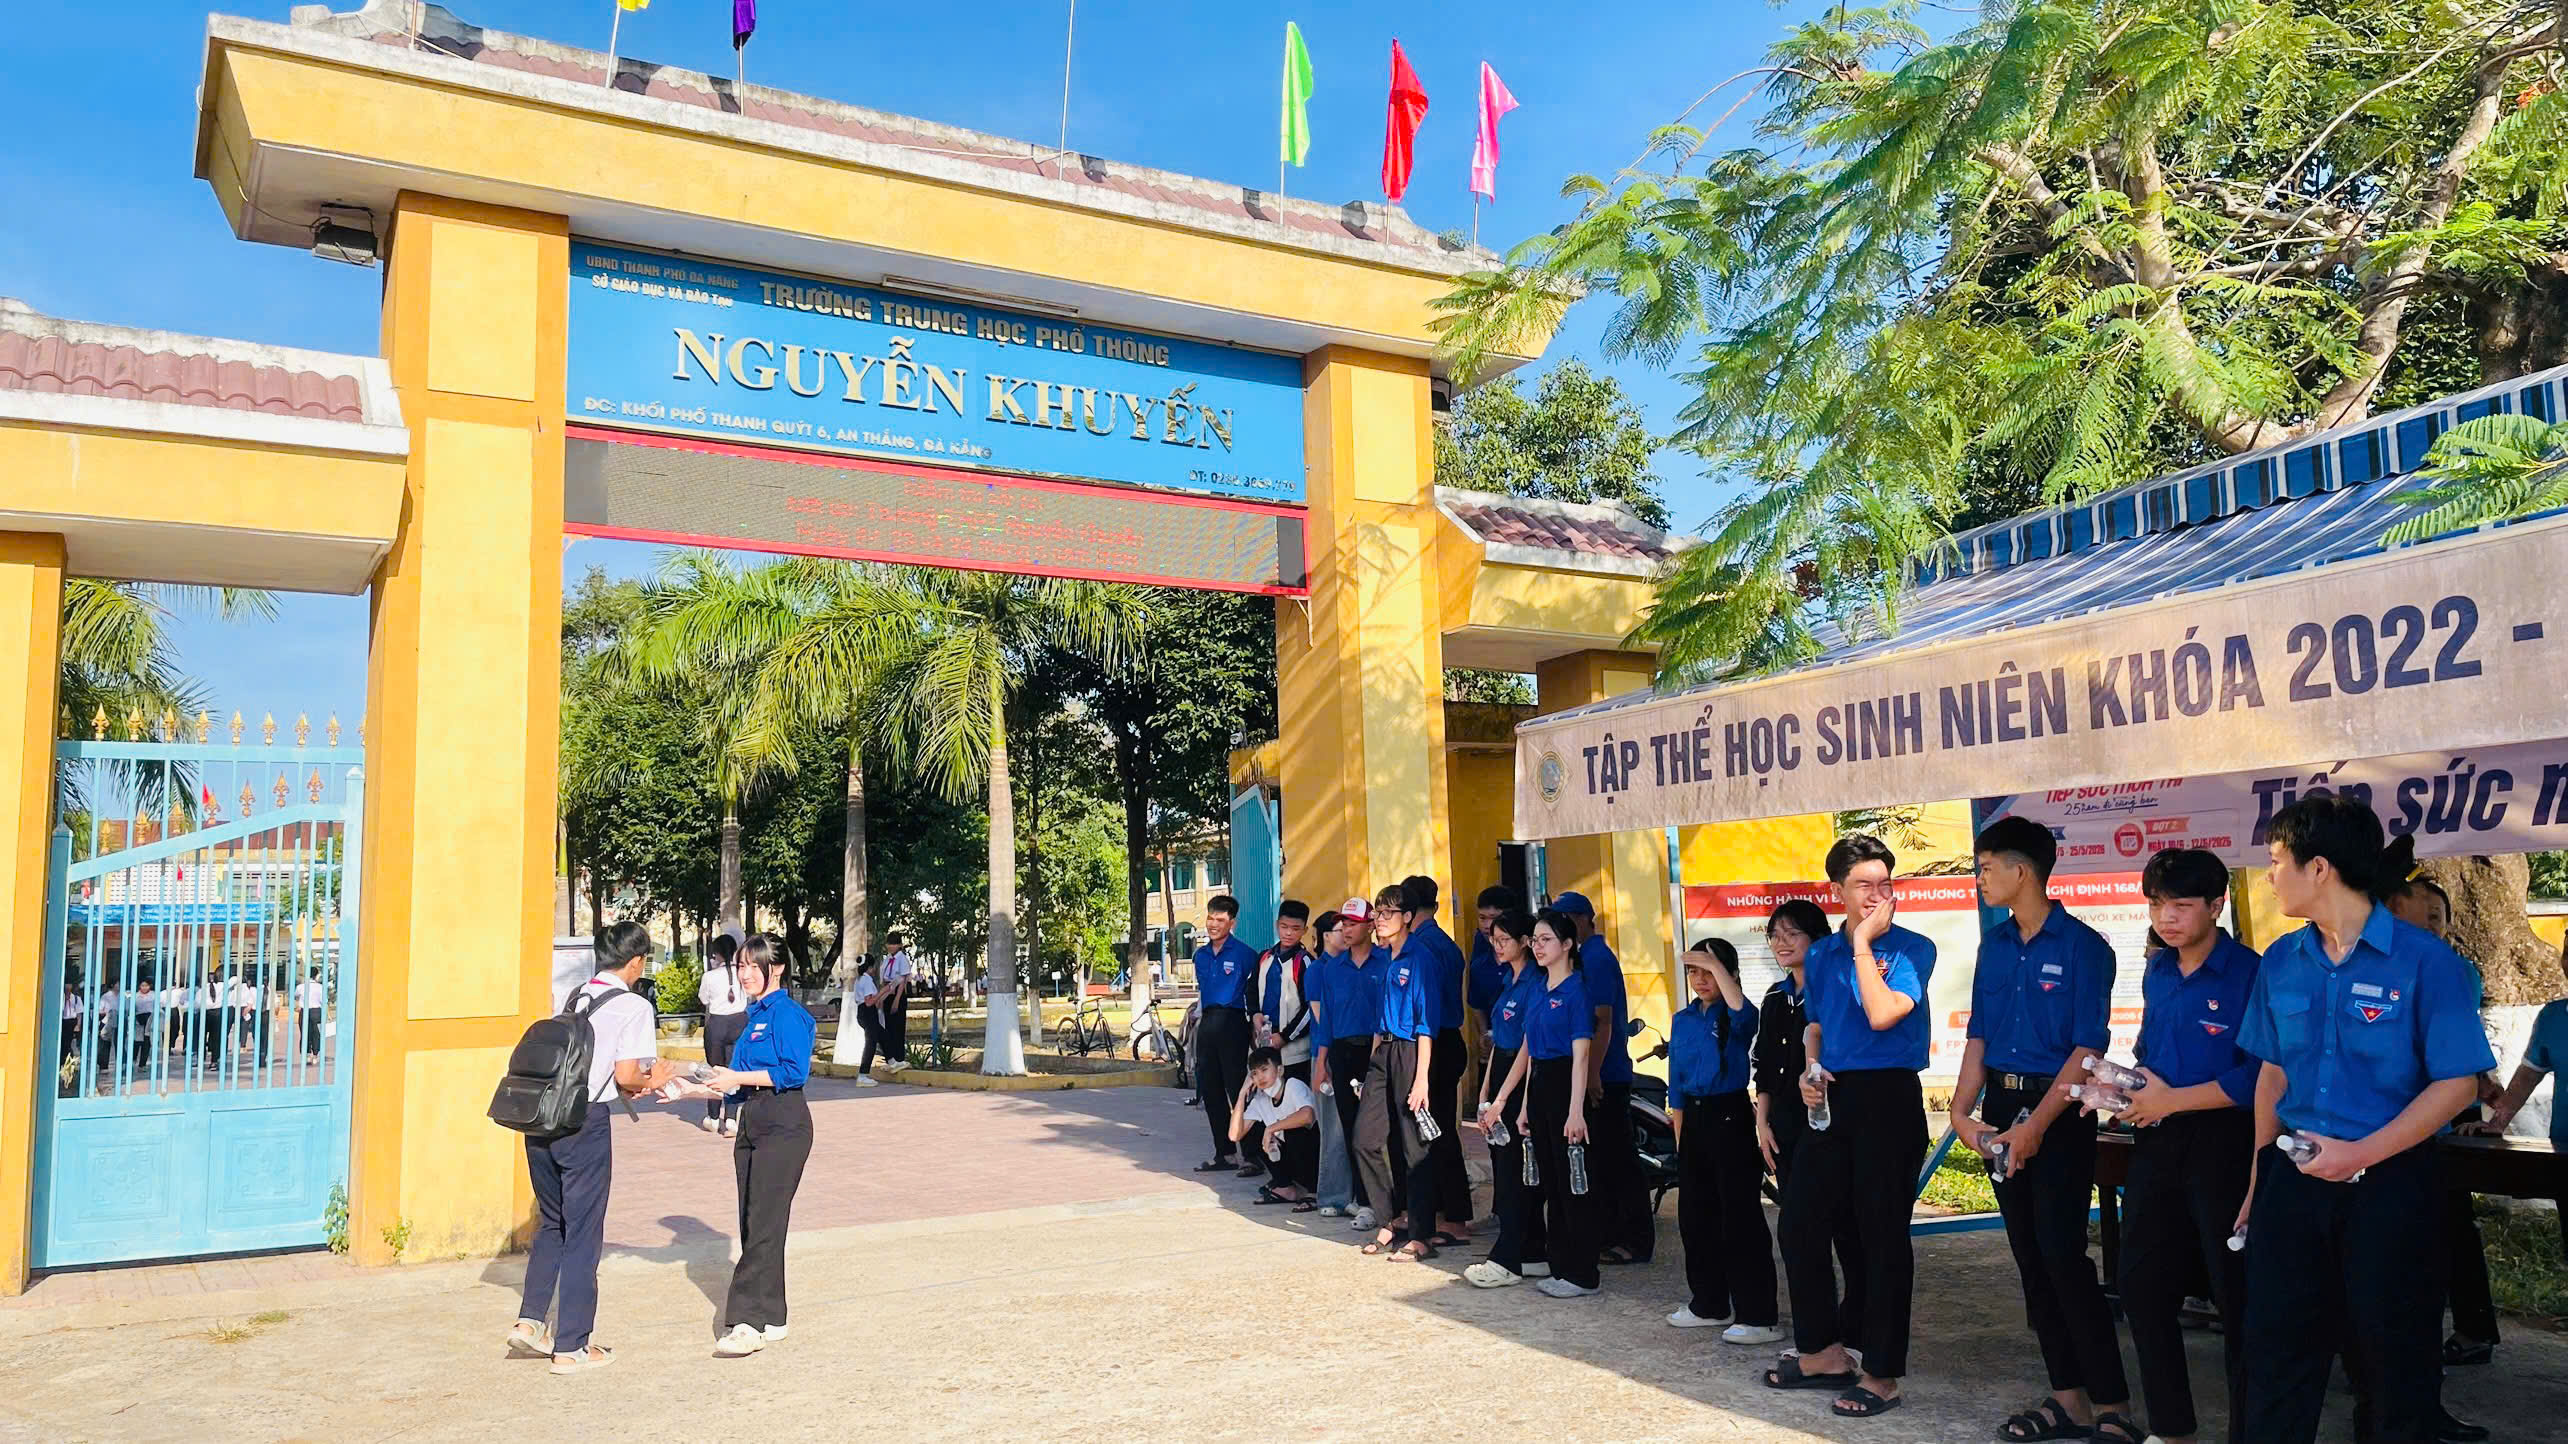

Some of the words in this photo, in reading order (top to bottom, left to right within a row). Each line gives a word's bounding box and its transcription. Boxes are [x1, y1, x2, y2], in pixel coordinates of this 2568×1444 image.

[668, 285, 683, 300] VÀ
[760, 281, 872, 321] TRƯỜNG
[880, 301, 968, 335] TRUNG
[976, 316, 1027, 348] HỌC
[1035, 325, 1086, 354] PHỔ
[1093, 335, 1170, 366] THÔNG
[584, 397, 616, 413] ĐC:
[621, 400, 665, 419] KHỐI
[670, 406, 707, 424] PHỐ
[711, 412, 767, 432] THANH
[771, 420, 813, 437] QUÝT
[817, 426, 831, 441] 6,
[836, 428, 858, 442] AN
[673, 327, 968, 417] NGUYỄN
[985, 375, 1234, 452] KHUYẾN
[1582, 732, 1640, 804] TẬP
[1650, 704, 1713, 787] THỂ
[1724, 713, 1801, 787] HỌC
[1816, 692, 1923, 766] SINH
[1939, 661, 2068, 750] NIÊN
[2087, 625, 2265, 730] KHÓA
[2286, 595, 2482, 702] 2022
[2512, 621, 2543, 642] -
[2388, 757, 2514, 837] sức
[1727, 894, 1773, 906] NHỮNG
[1815, 894, 1828, 904] VI
[1909, 888, 1966, 901] PHƯƠNG
[2077, 883, 2111, 896] ĐỊNH
[2113, 881, 2143, 893] 168/
[2112, 912, 2126, 921] XE
